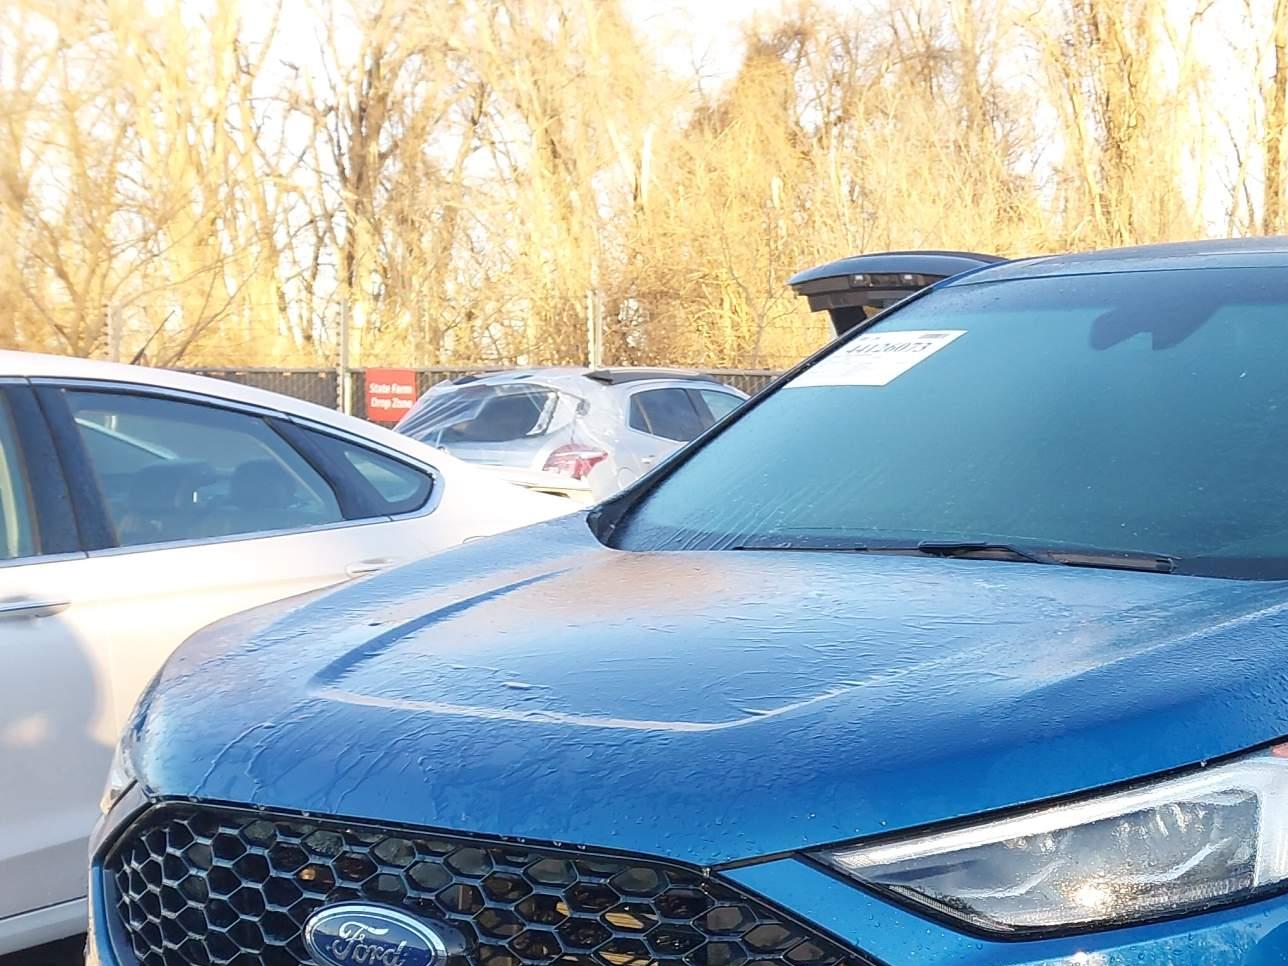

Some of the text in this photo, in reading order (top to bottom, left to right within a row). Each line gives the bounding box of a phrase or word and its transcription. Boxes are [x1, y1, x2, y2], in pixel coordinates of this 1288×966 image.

[369, 383, 412, 394] State Farm
[371, 397, 413, 410] Drop Zone
